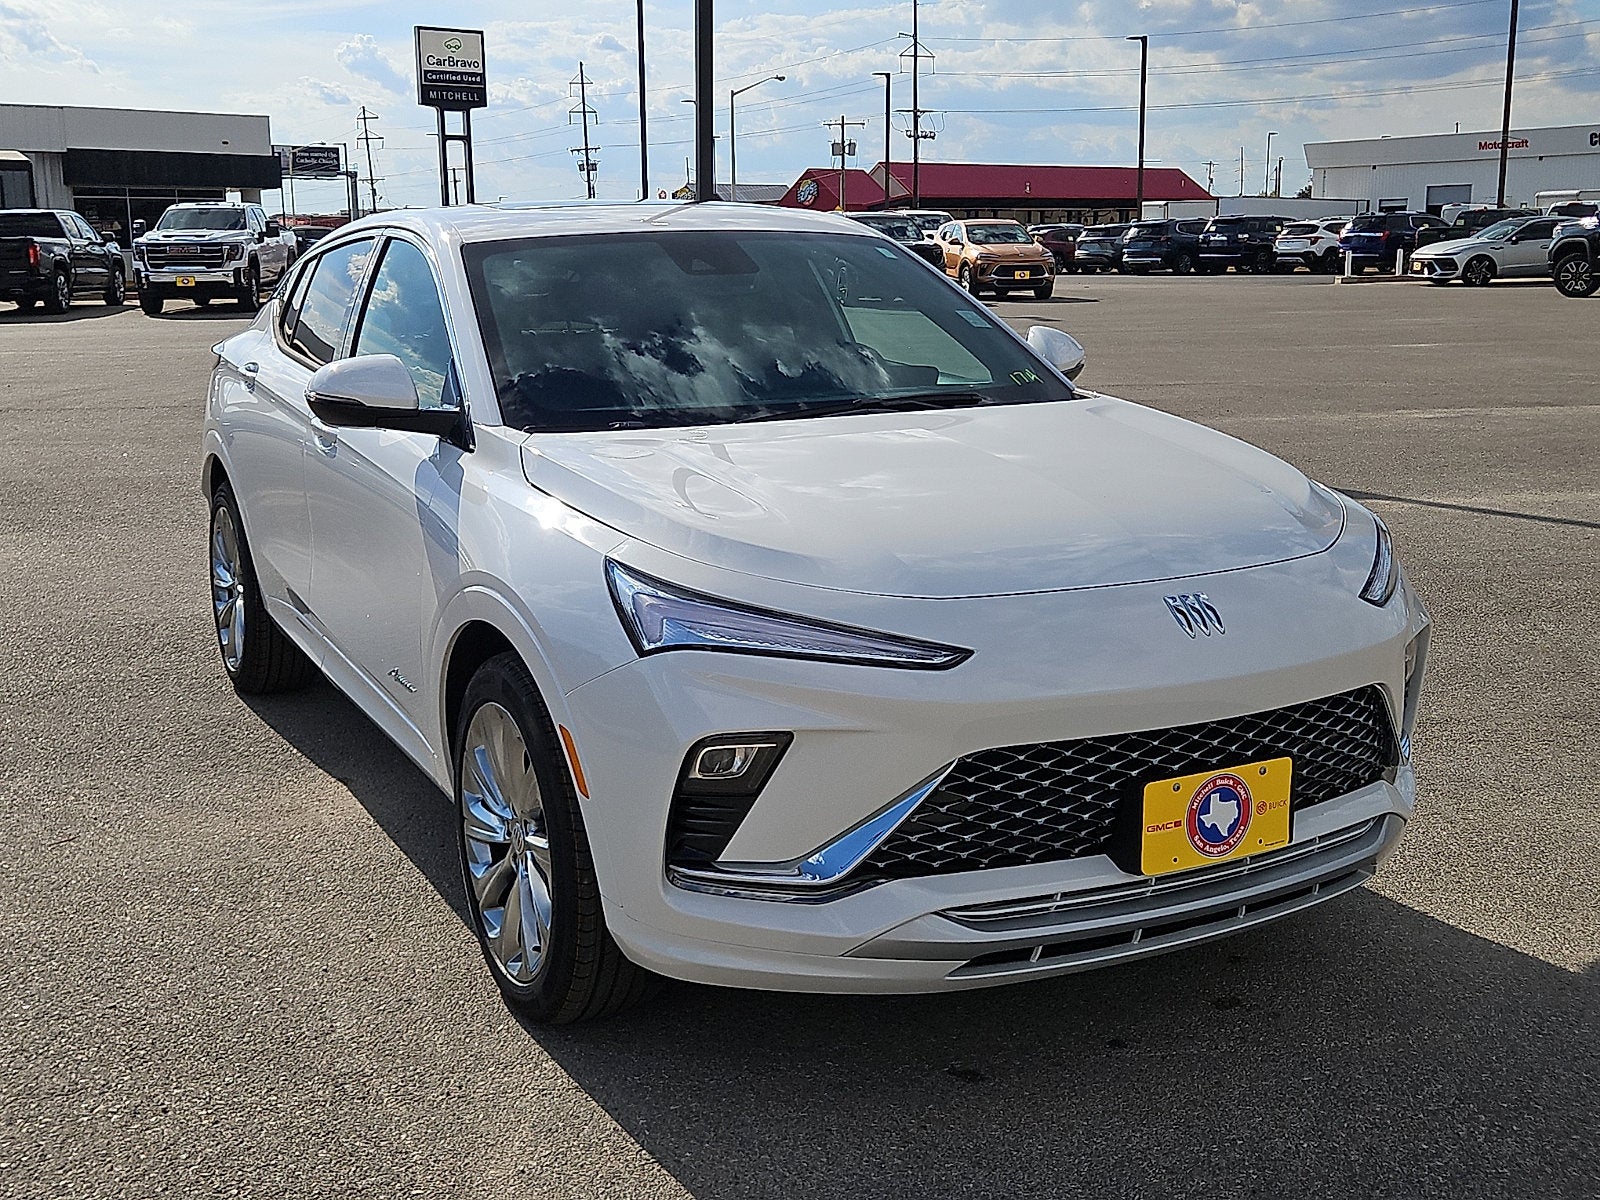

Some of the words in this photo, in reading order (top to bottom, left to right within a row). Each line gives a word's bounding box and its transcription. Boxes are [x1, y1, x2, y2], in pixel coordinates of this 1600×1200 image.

[426, 54, 480, 69] CarBravo
[427, 72, 461, 81] Certified
[462, 74, 481, 82] Used
[429, 90, 480, 101] MITCHELL
[1478, 138, 1529, 151] Motocraft
[1191, 782, 1214, 810] Mitchell
[1216, 778, 1234, 786] Buick
[1236, 784, 1248, 801] GMC
[1268, 799, 1288, 810] BUICK
[1146, 820, 1174, 833] GMC
[1193, 834, 1204, 849] San
[1204, 844, 1230, 854] Angelo,
[1229, 825, 1245, 846] Texas
